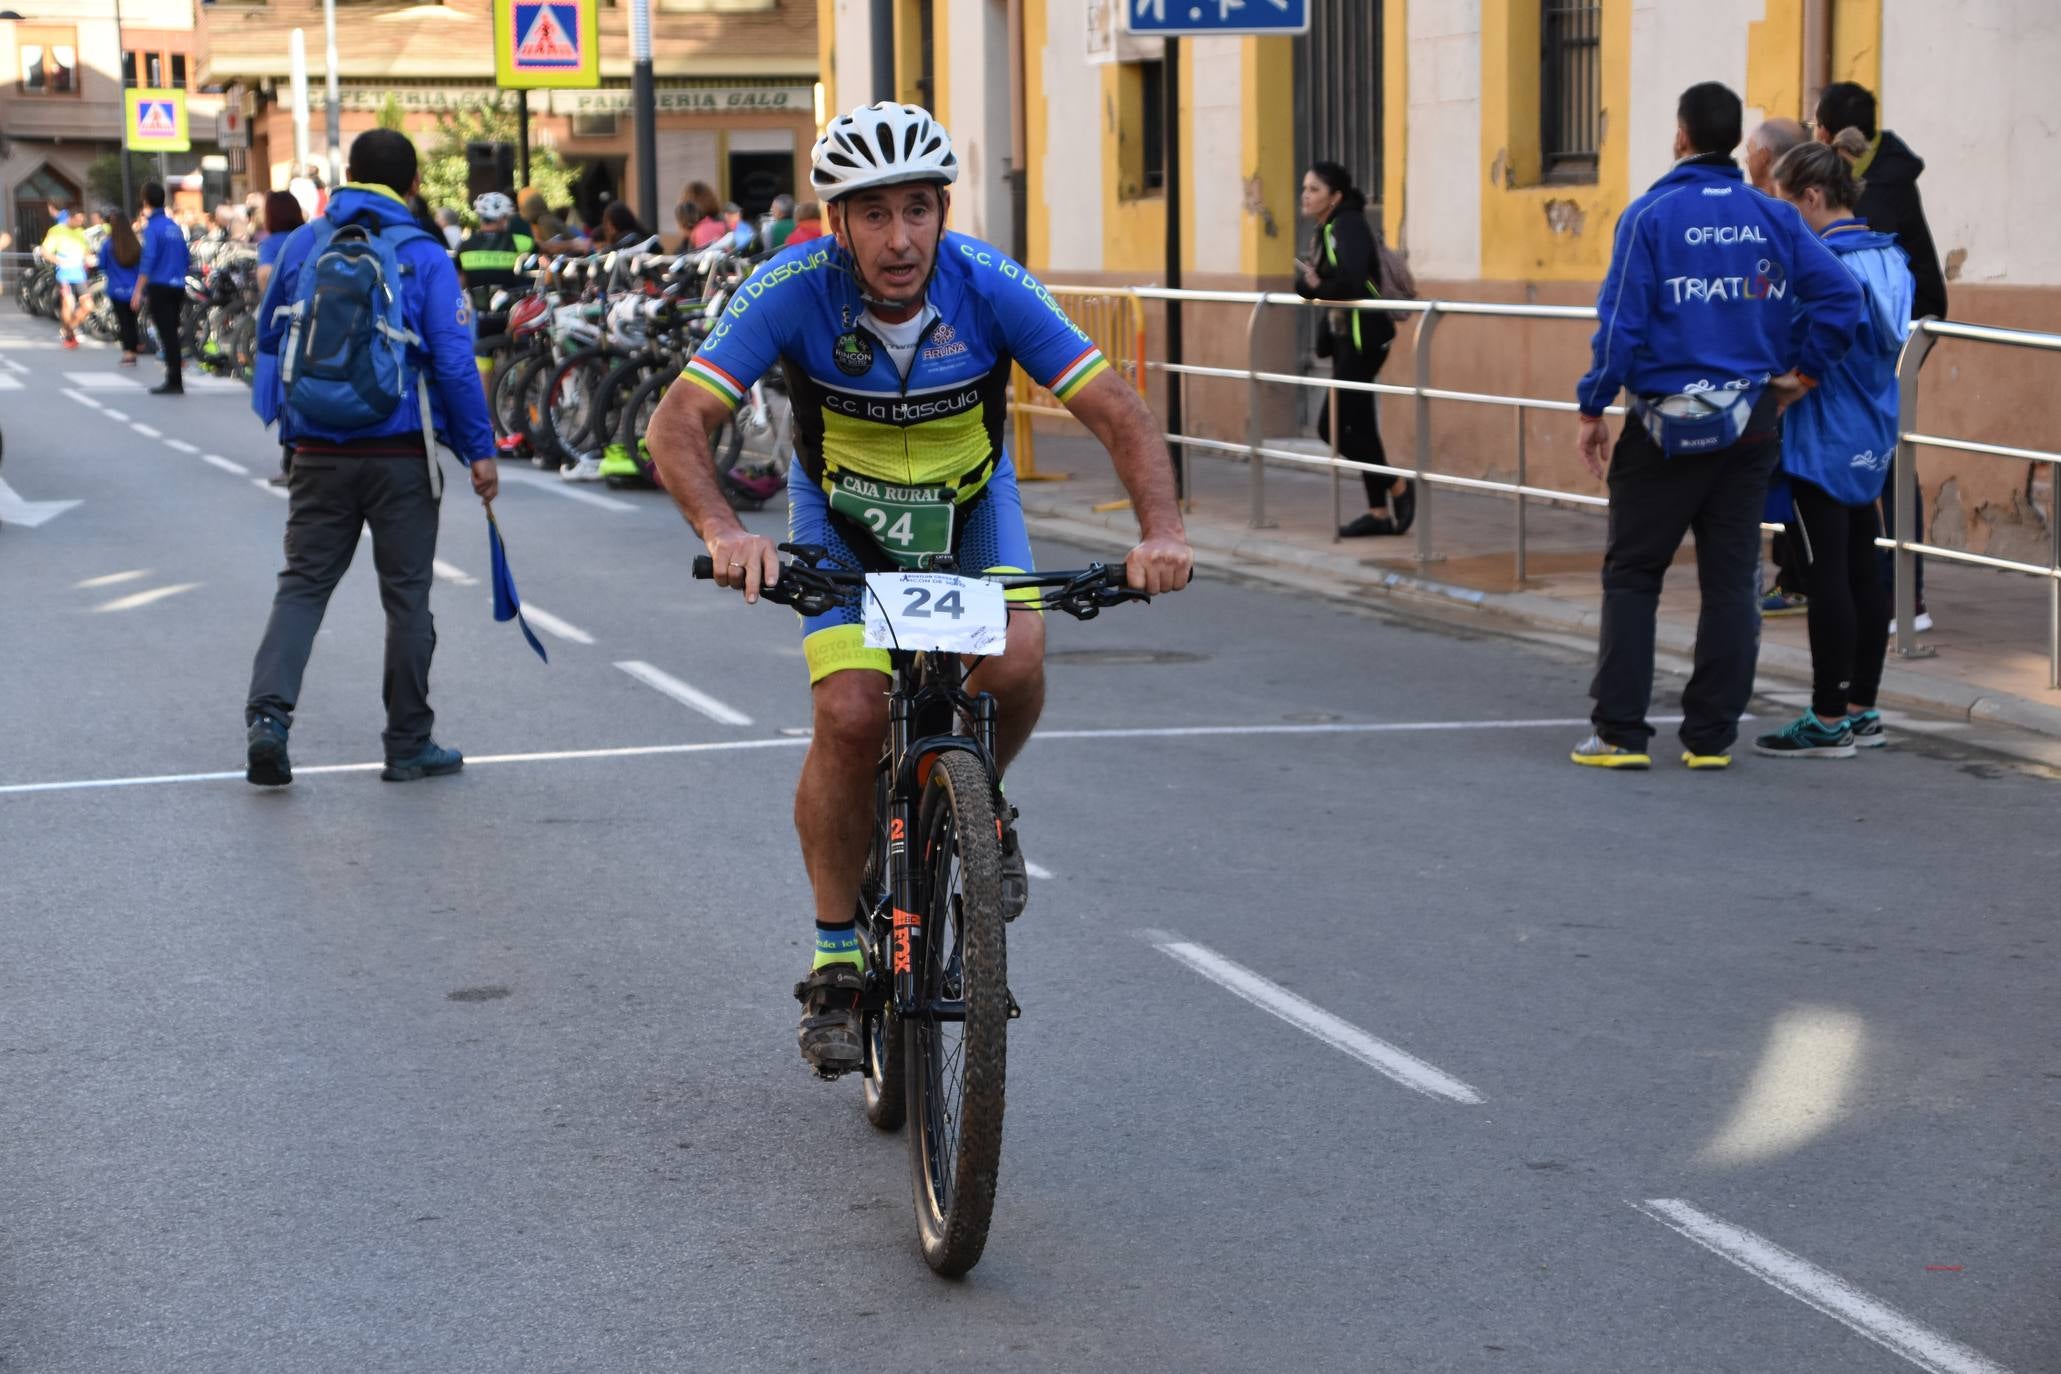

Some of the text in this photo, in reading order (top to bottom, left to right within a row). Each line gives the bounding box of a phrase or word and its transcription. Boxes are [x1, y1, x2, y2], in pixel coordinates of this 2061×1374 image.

[307, 90, 448, 106] CFETERIA
[577, 91, 788, 109] PANERIA GALO
[1685, 225, 1767, 245] OFICIAL
[999, 259, 1020, 279] la
[728, 296, 749, 318] la
[745, 250, 829, 299] bascula
[923, 342, 968, 360] BRUNA
[868, 402, 885, 419] la
[893, 390, 978, 420] bascula
[843, 476, 879, 497] CAJA
[864, 508, 914, 546] 24
[902, 587, 965, 619] 24
